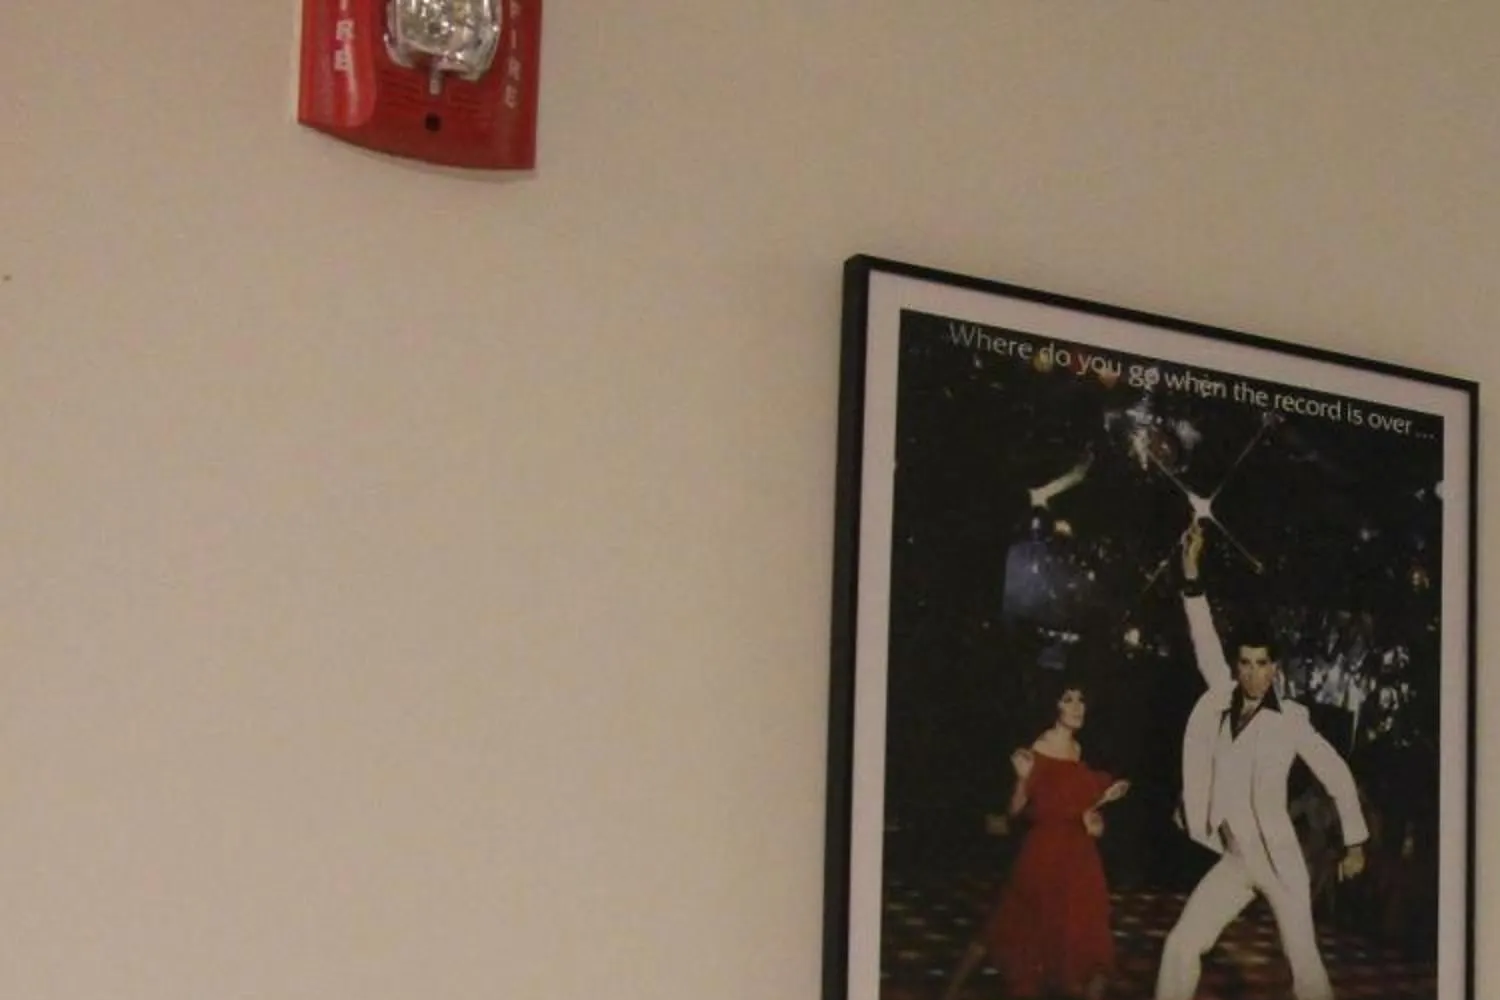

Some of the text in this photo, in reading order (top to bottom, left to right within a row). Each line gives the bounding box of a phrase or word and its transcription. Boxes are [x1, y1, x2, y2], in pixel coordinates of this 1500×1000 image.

[949, 322, 1034, 361] Where
[1038, 342, 1071, 367] do
[1075, 352, 1122, 376] you
[1128, 364, 1160, 388] go
[1163, 371, 1227, 399] when
[1233, 380, 1269, 405] the
[1274, 392, 1342, 421] record
[1346, 402, 1363, 426] is
[1367, 411, 1412, 435] over
